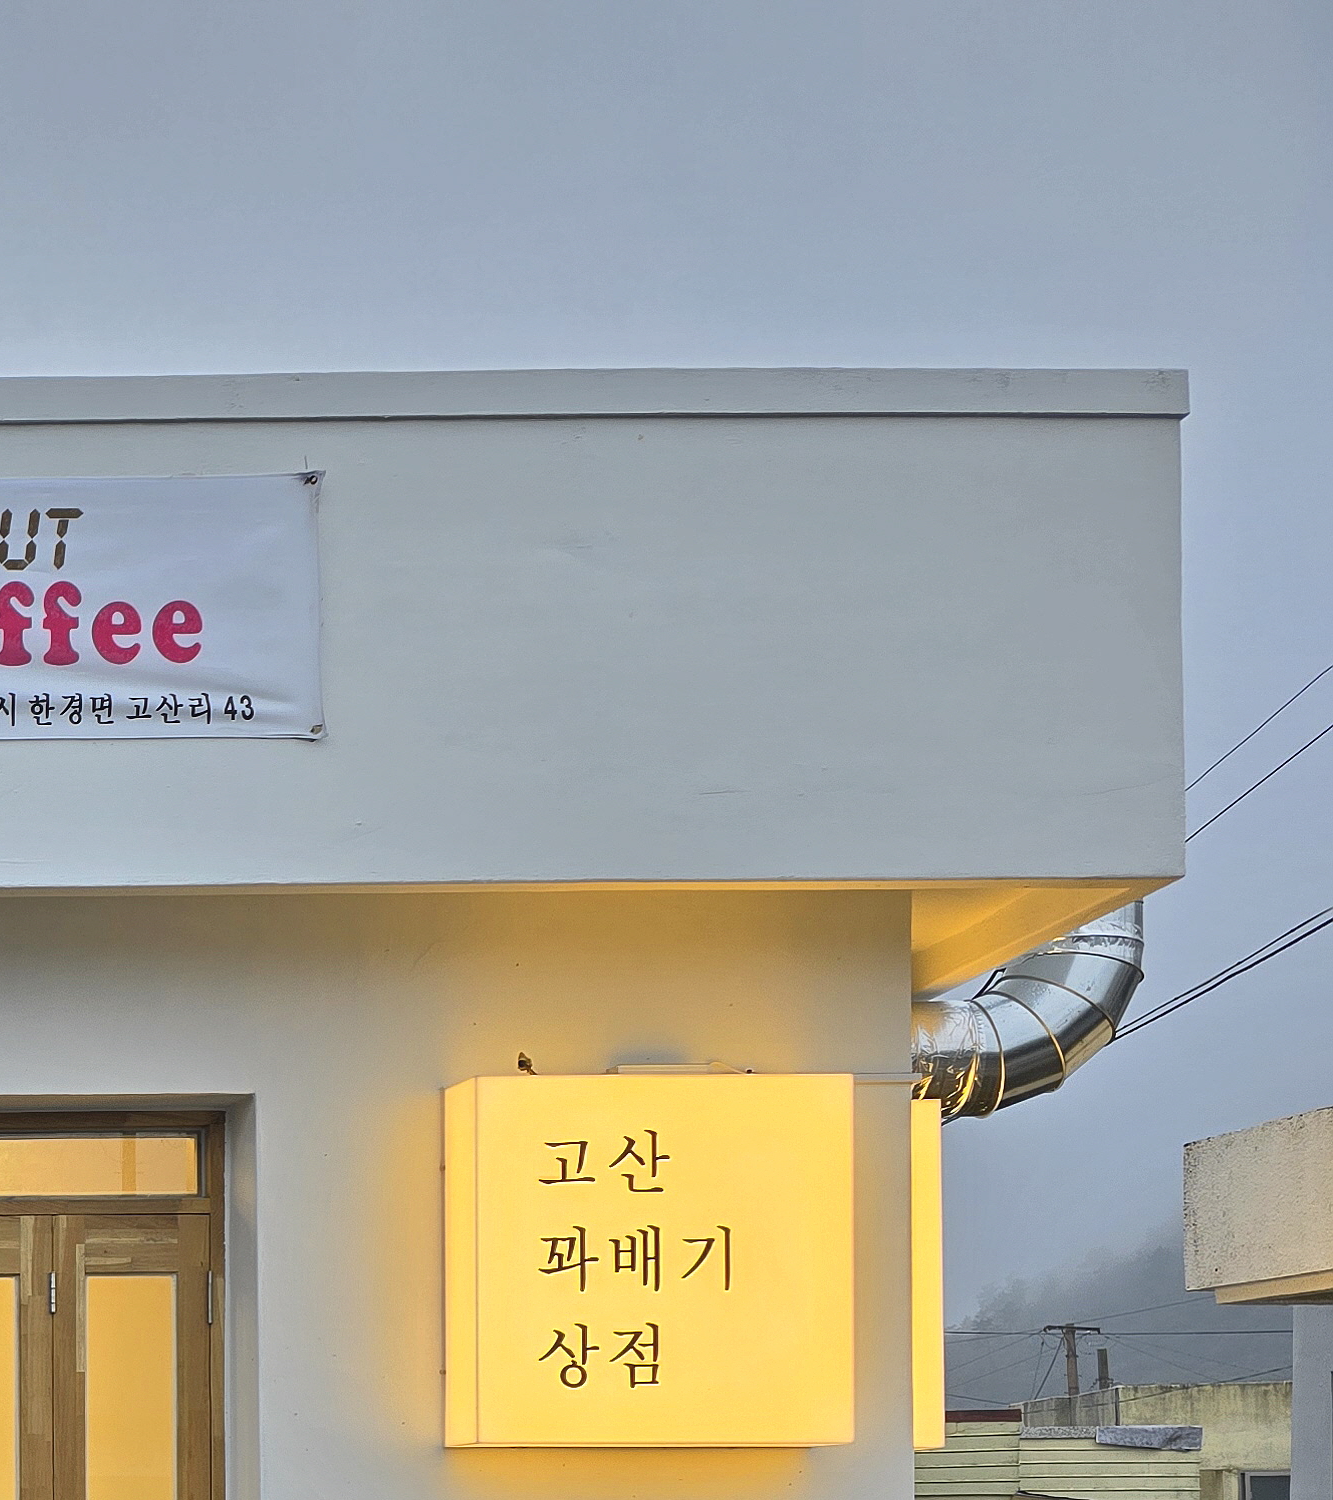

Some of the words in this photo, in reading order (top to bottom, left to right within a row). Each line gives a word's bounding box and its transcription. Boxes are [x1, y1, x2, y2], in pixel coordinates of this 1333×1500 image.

[28, 692, 115, 727] 한경면
[124, 692, 211, 727] 고산리
[222, 695, 256, 722] 43
[538, 1129, 671, 1193] 고산
[538, 1224, 732, 1293] 꽈배기
[538, 1321, 662, 1389] 상점
